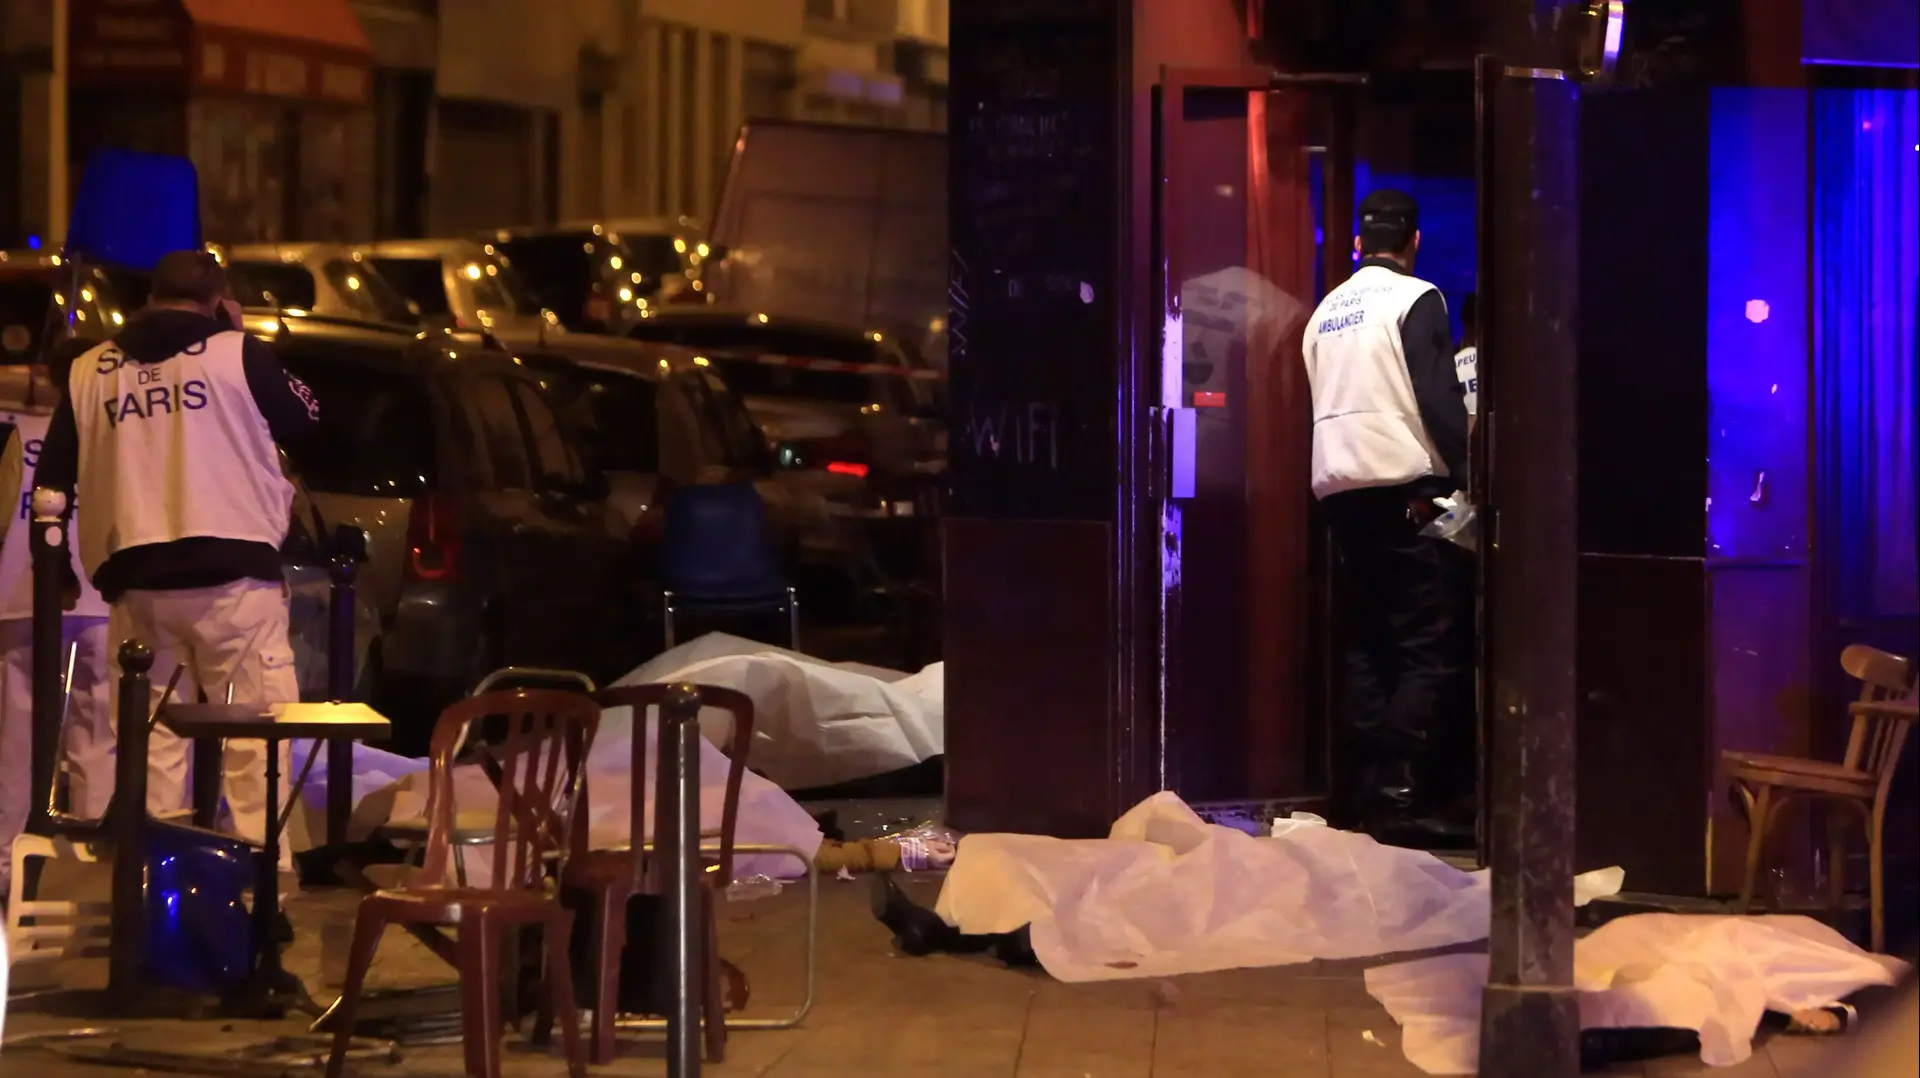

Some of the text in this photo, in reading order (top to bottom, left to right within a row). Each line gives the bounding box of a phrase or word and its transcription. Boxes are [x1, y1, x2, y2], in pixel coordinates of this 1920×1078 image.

[1318, 310, 1365, 334] AMBULANCIER
[137, 366, 162, 386] DE
[103, 379, 208, 429] PARIS
[968, 401, 1059, 471] WIFI
